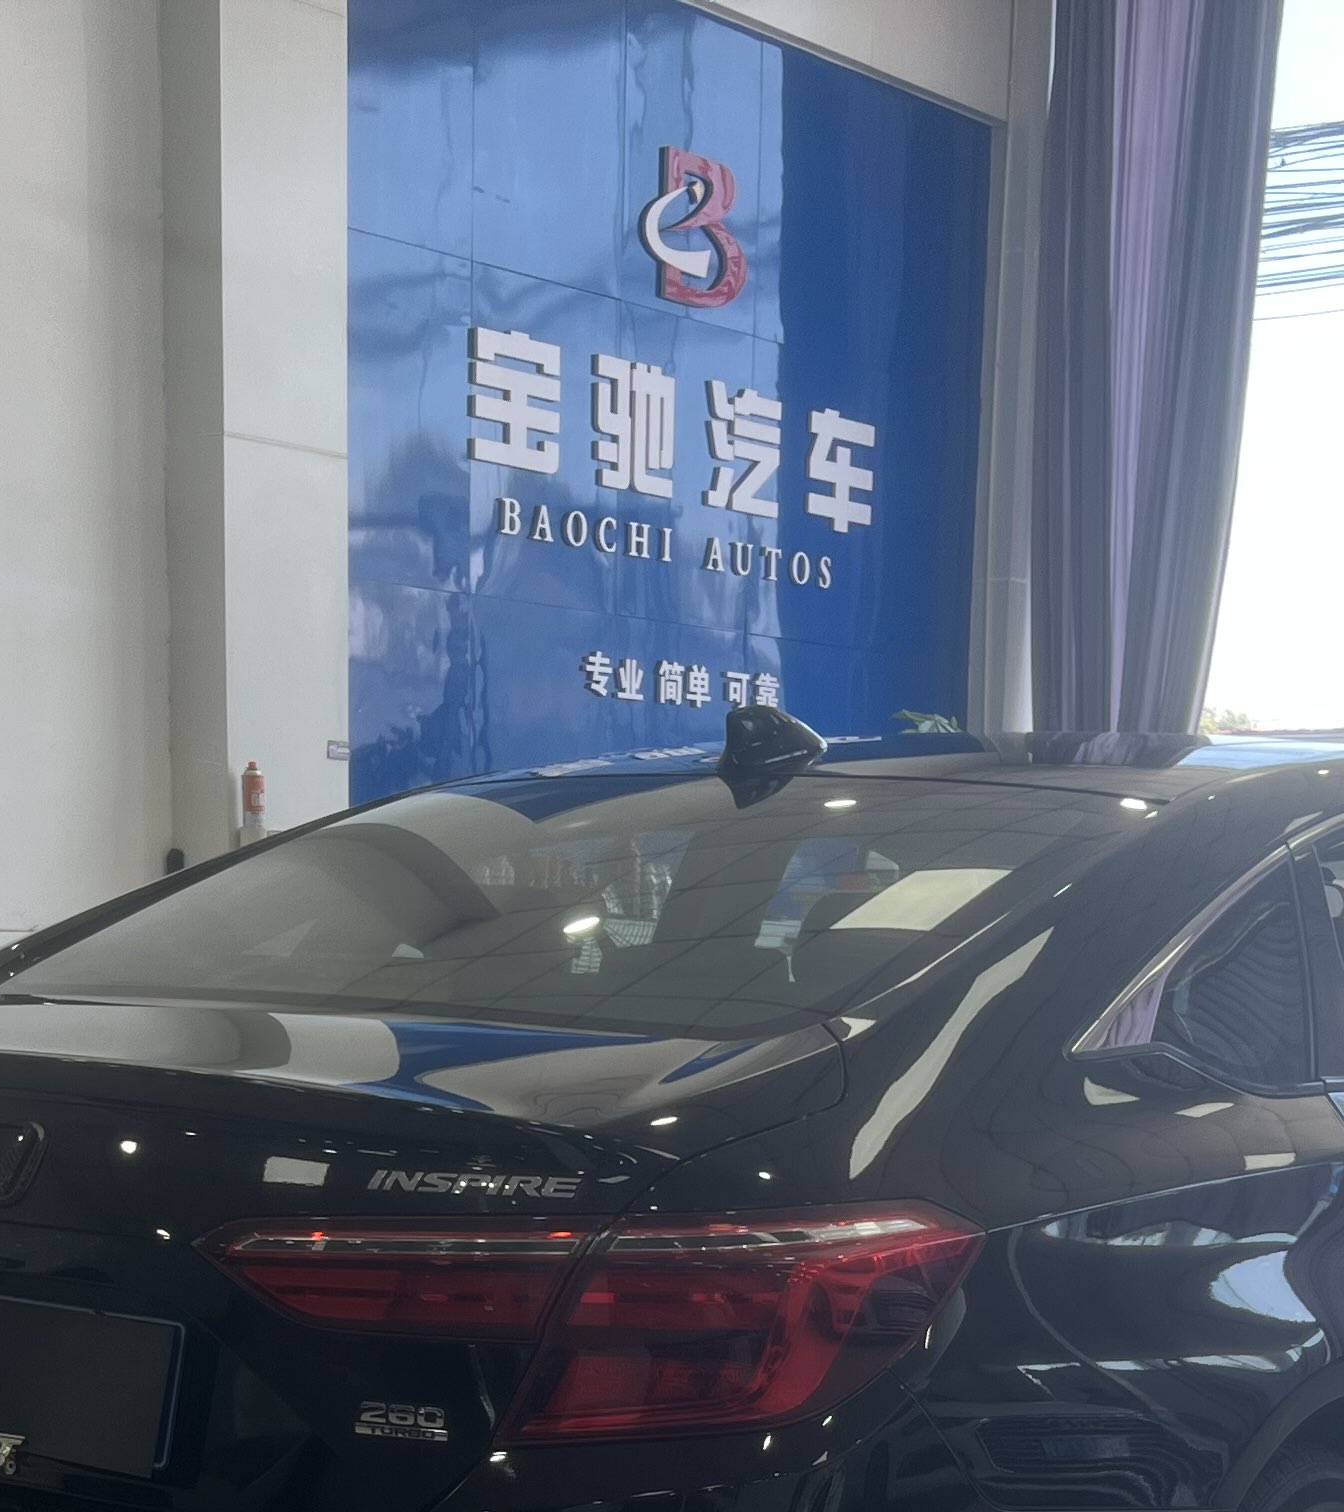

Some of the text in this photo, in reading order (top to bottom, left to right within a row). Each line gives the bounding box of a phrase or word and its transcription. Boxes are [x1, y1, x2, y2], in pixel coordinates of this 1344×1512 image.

[468, 326, 875, 533] 宝驰汽车
[498, 497, 832, 589] BAOCHI AUTOS
[583, 651, 780, 708] 专业 简单 可靠
[367, 1169, 582, 1199] INSPIRE
[359, 1400, 445, 1429] 260
